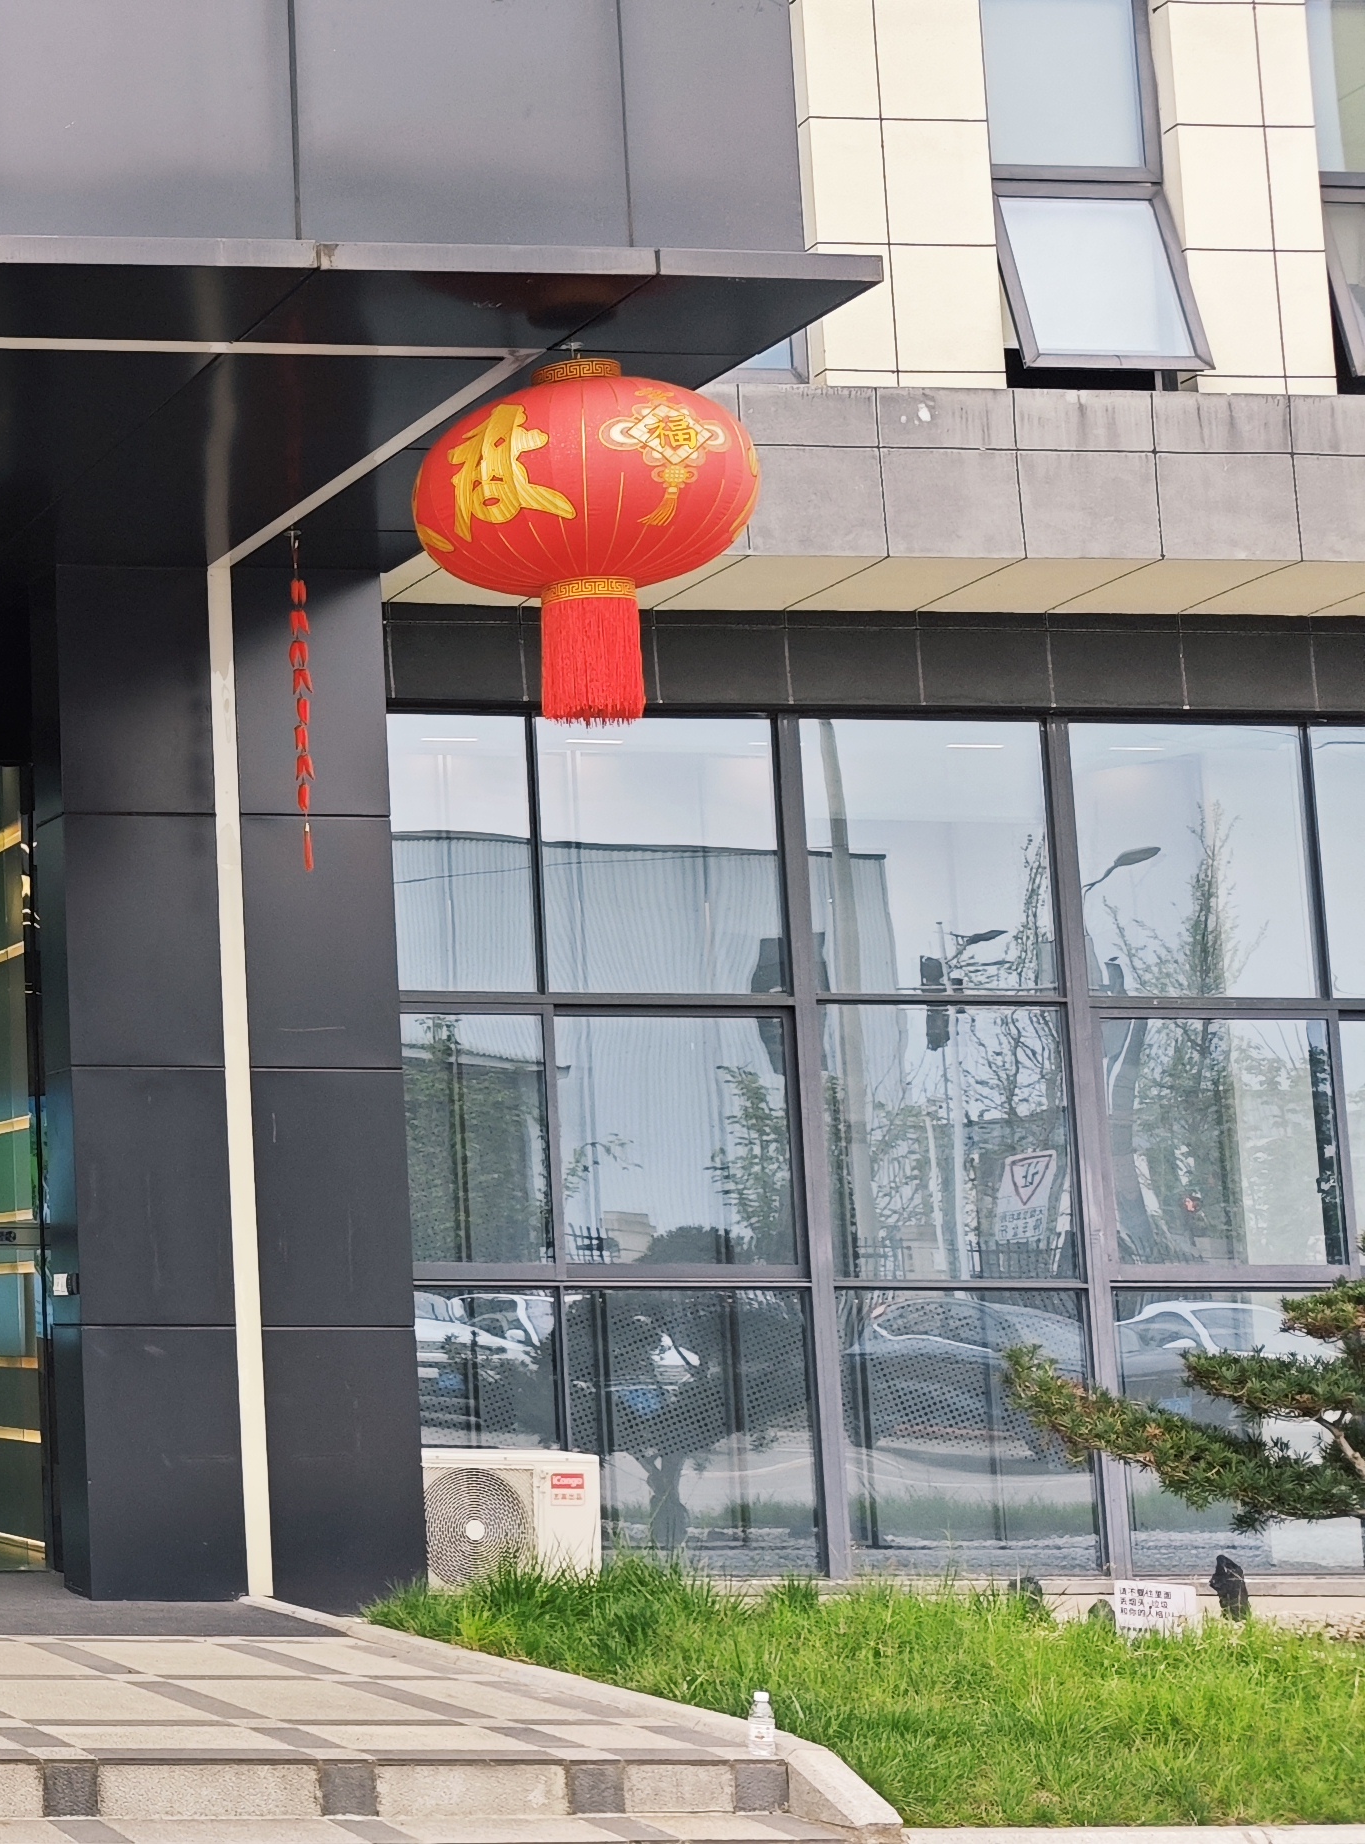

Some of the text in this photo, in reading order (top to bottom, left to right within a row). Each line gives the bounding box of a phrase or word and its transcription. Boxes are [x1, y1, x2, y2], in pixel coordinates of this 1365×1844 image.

[644, 412, 699, 449] 福
[447, 404, 578, 542] 春
[1119, 1587, 1171, 1599] 请不要往里面
